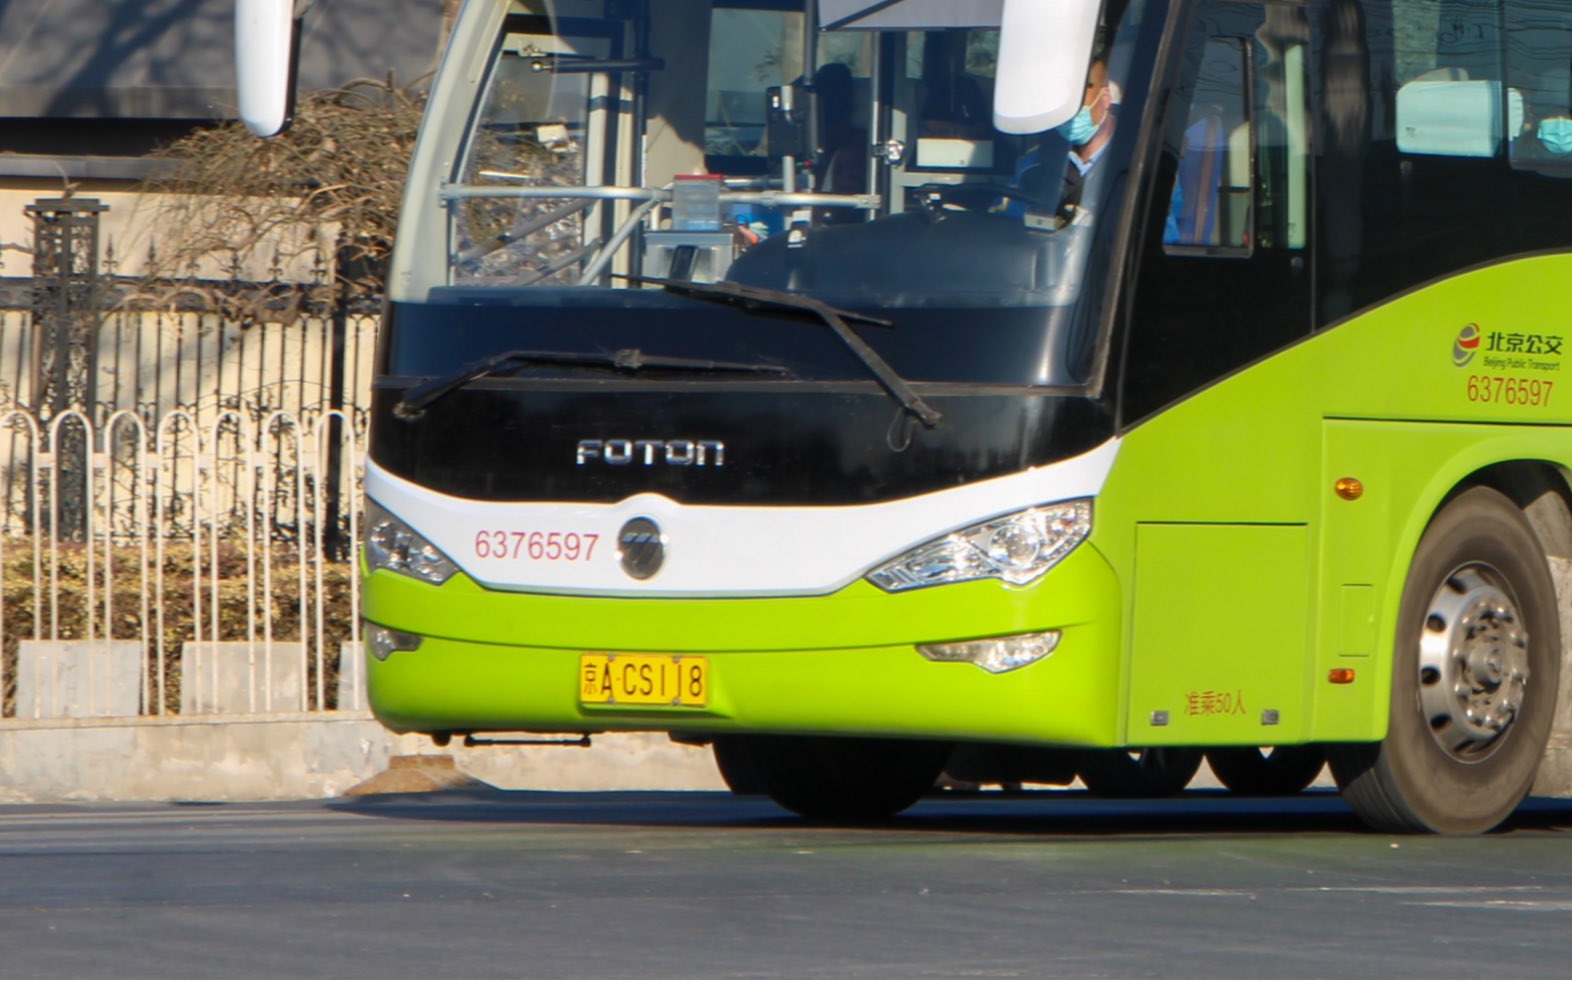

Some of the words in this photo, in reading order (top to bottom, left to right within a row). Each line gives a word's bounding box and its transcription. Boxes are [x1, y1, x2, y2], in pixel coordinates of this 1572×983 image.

[1486, 331, 1564, 355] 北京公交
[1483, 356, 1506, 371] Beijing
[1467, 374, 1554, 407] 6376597
[576, 439, 725, 466] FOTON
[475, 529, 600, 561] 6376597
